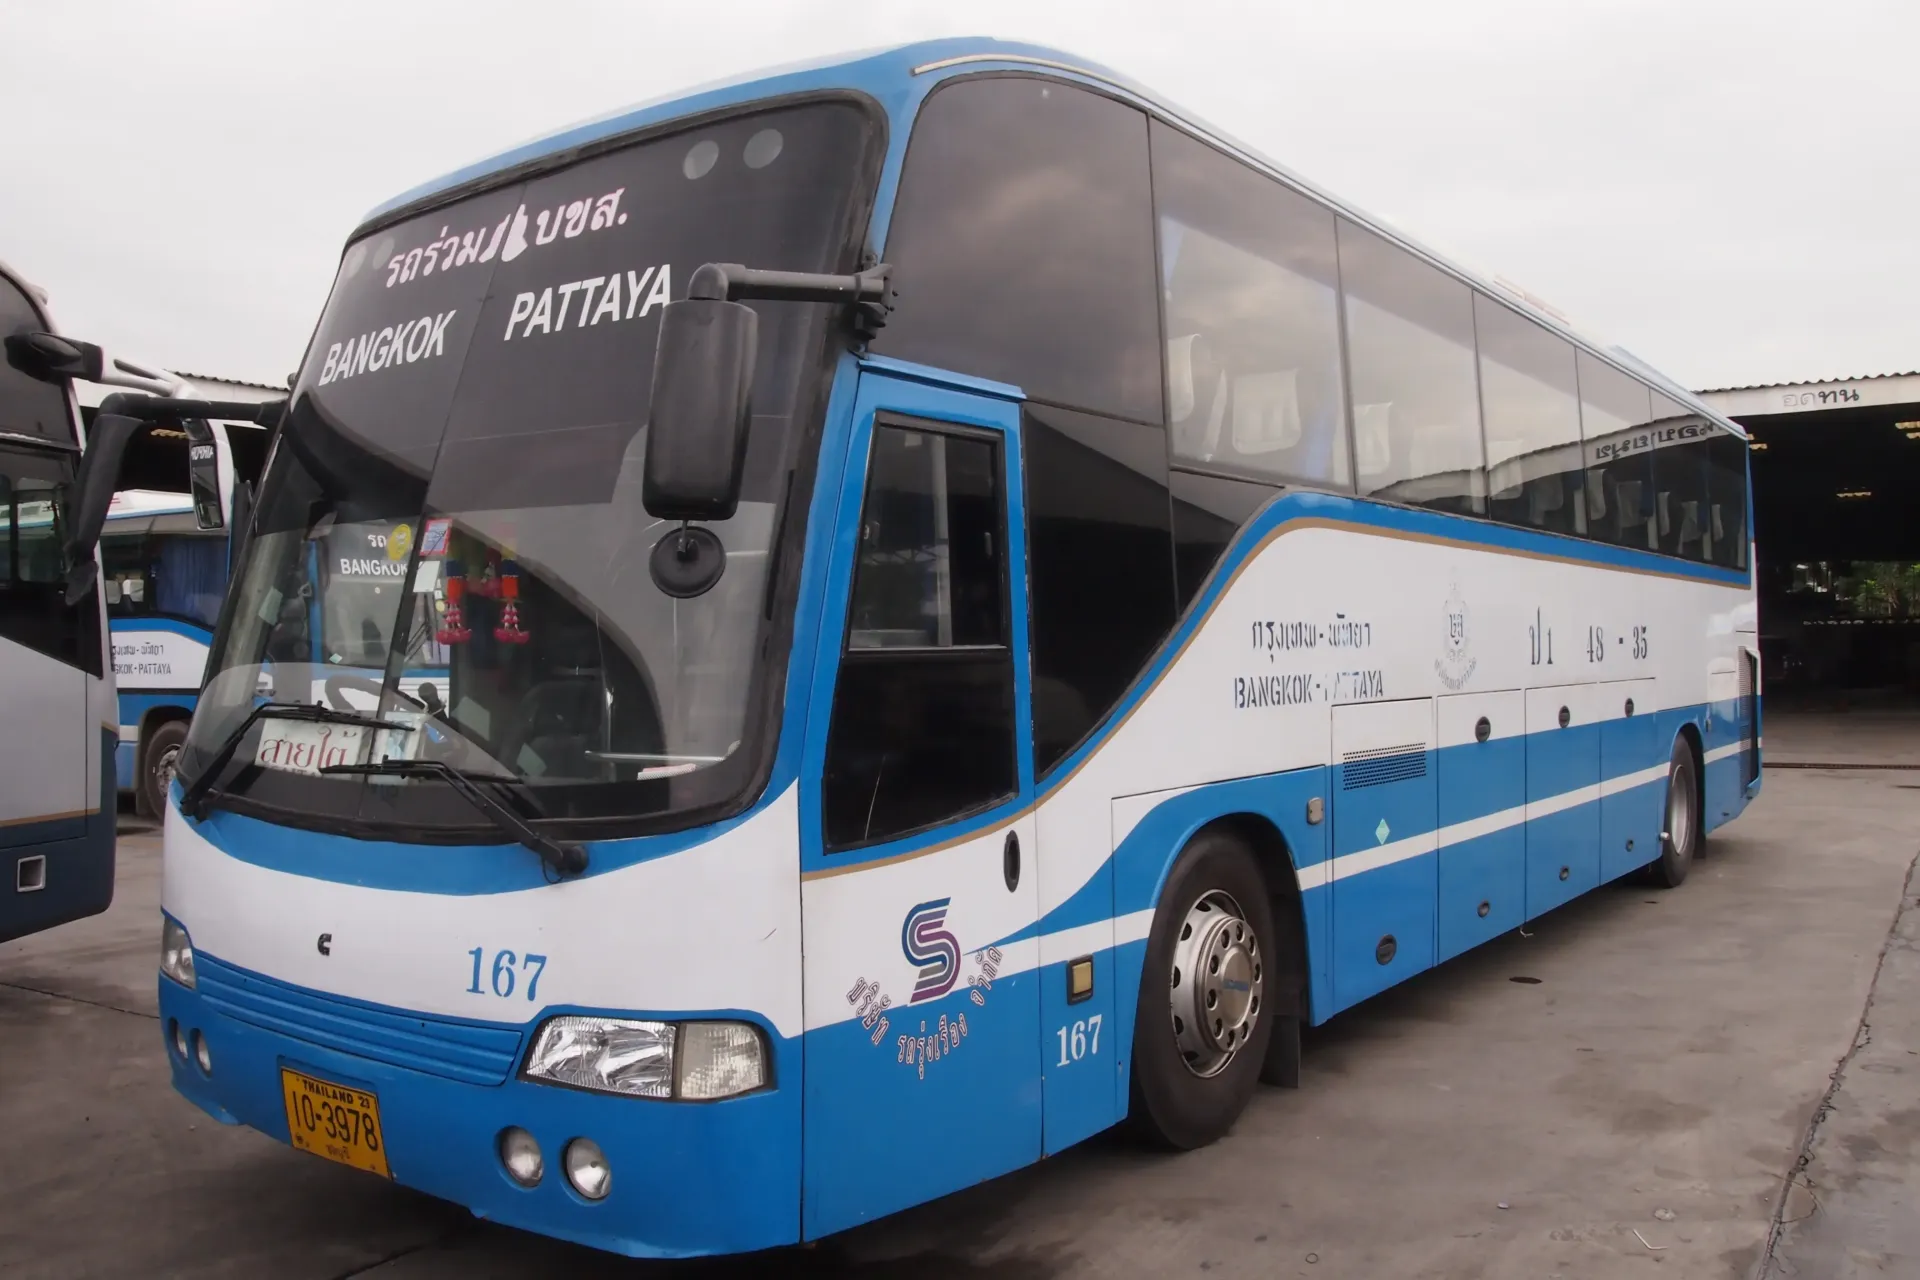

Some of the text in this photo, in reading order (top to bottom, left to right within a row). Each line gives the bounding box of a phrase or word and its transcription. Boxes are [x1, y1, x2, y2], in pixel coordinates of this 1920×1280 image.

[385, 221, 484, 288] รถร่วม
[503, 263, 672, 342] PATTAYA
[318, 309, 457, 387] BANGKOK
[114, 663, 172, 675] GKOK-PATTAYA
[466, 947, 547, 1002] 167
[1056, 1014, 1102, 1067] 167
[302, 1079, 354, 1105] THAILAND
[293, 1091, 379, 1152] 10-3978
